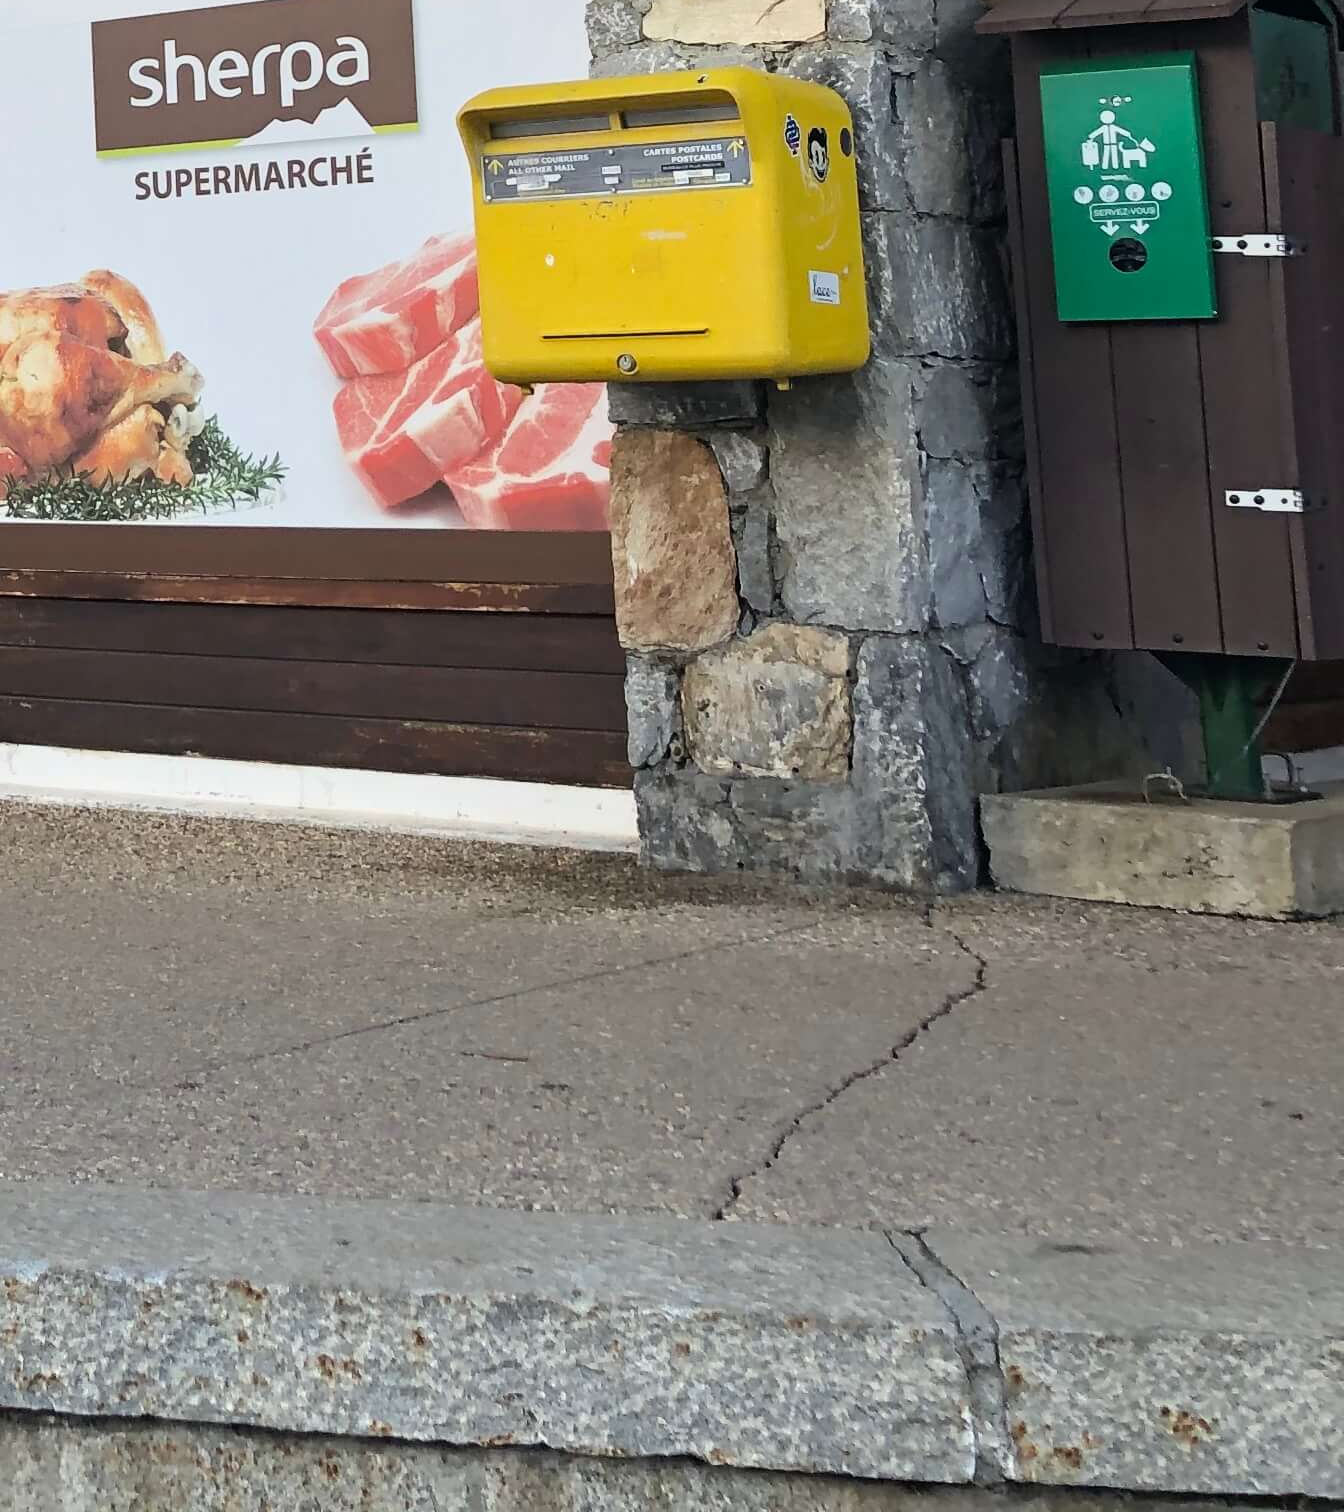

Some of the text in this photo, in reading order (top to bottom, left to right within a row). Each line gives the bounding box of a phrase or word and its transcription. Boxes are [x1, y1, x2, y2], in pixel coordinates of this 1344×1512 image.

[128, 35, 370, 108] sherpa
[643, 143, 722, 157] CARTES POSTALES
[507, 154, 590, 167] AUTRES COURRIERS
[671, 153, 723, 163] POSTCARDS
[134, 147, 375, 201] SUPERMARCHÉ
[525, 165, 552, 174] OTHER
[554, 163, 576, 172] MAIL
[1093, 206, 1156, 218] SERVEZ-VOUS
